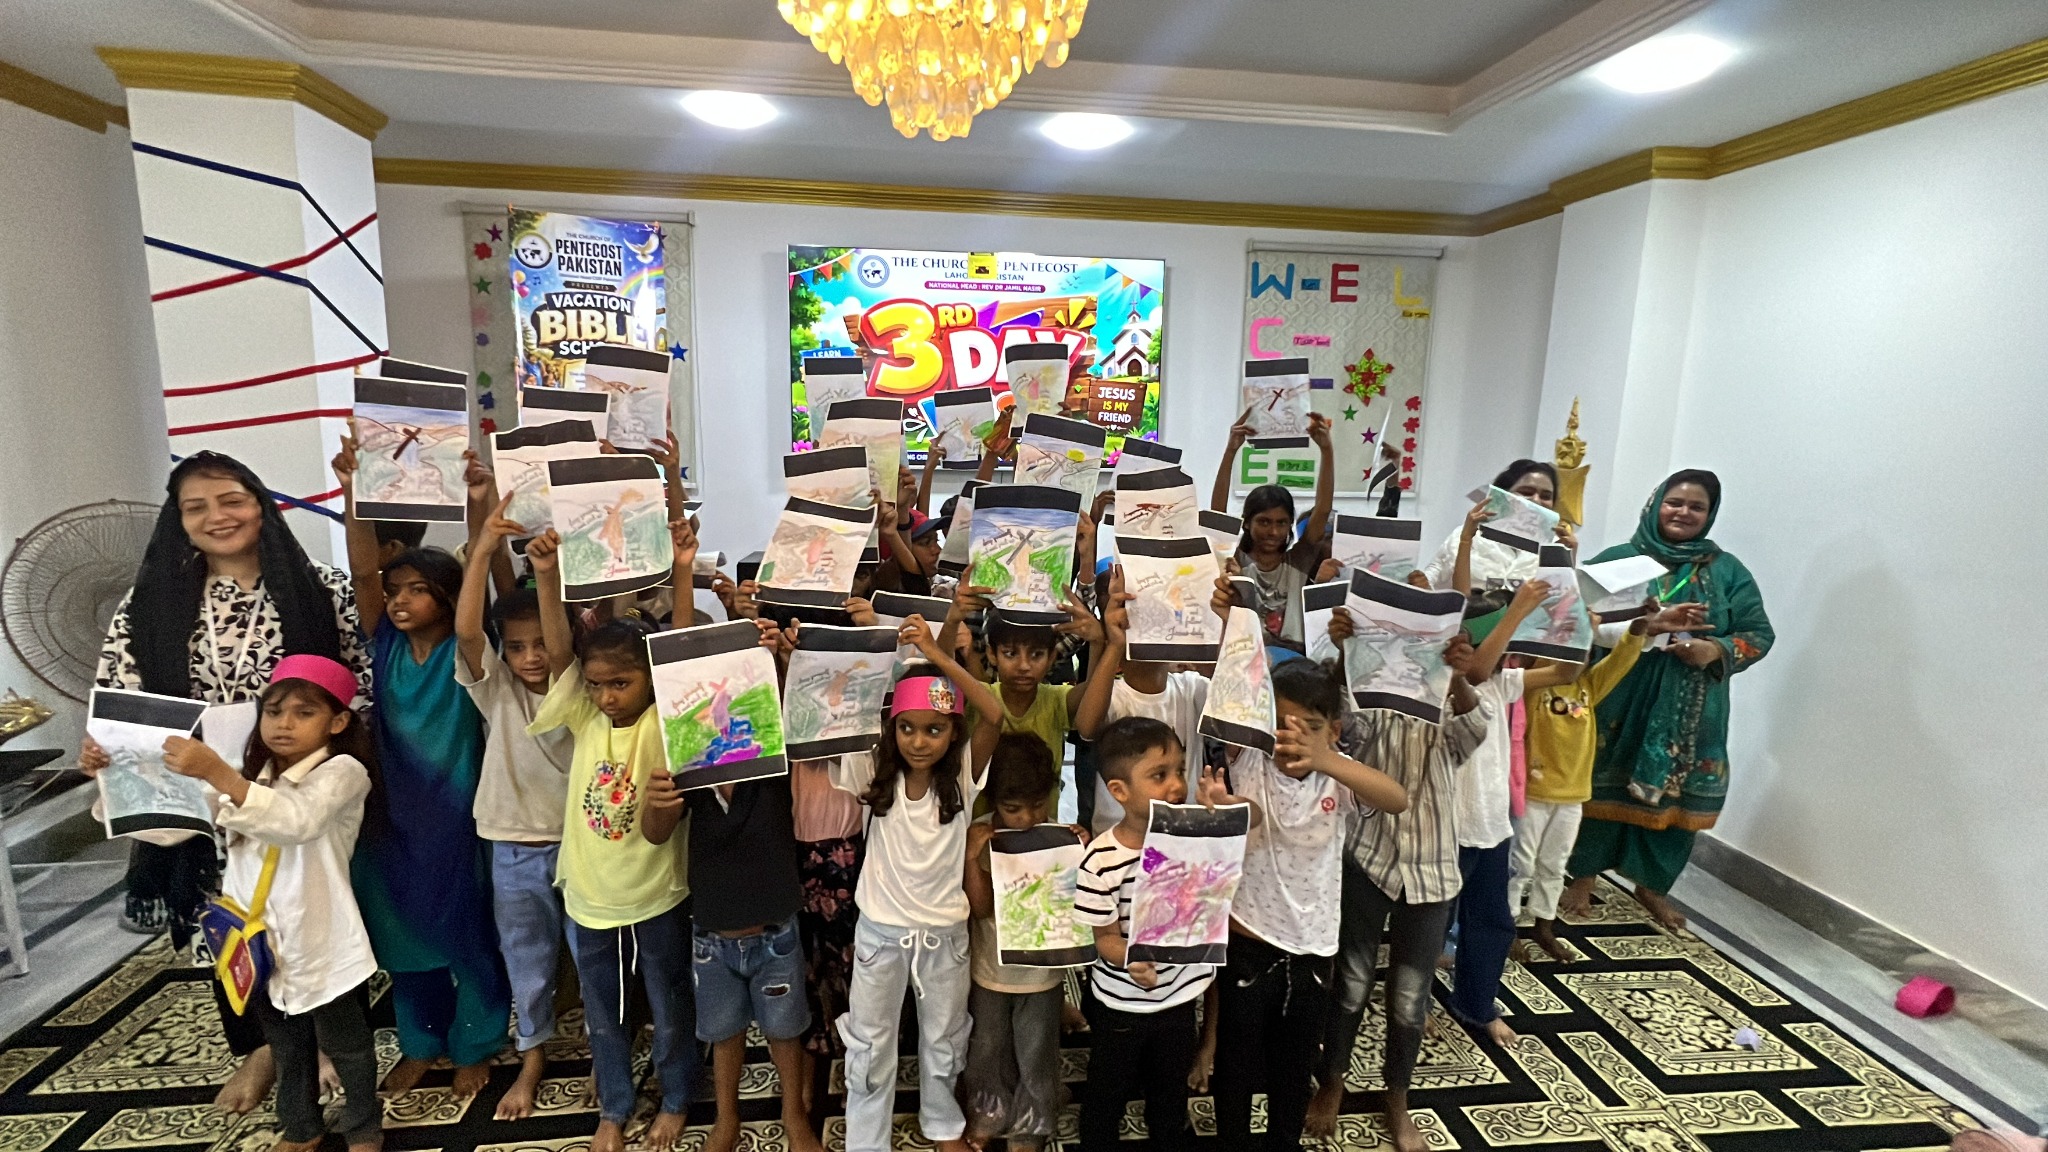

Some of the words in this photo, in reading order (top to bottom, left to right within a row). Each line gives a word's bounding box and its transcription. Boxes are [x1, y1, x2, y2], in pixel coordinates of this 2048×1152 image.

[556, 239, 622, 260] PENTECOST
[558, 255, 622, 276] PAKISTAN
[892, 257, 918, 267] THE
[922, 258, 968, 270] CHURC
[1004, 261, 1078, 273] PENTECOST
[1252, 261, 1295, 300] W
[1330, 263, 1359, 303] E
[1394, 265, 1423, 306] L
[552, 294, 631, 313] VACATION
[536, 309, 650, 351] BIBLE
[1250, 317, 1285, 358] C
[868, 302, 943, 394] 3
[938, 305, 974, 328] RD
[1098, 387, 1136, 400] JESUS
[1103, 401, 1112, 410] IS
[1114, 402, 1129, 411] MY
[1098, 412, 1131, 423] FRIEND
[1241, 447, 1269, 484] E
